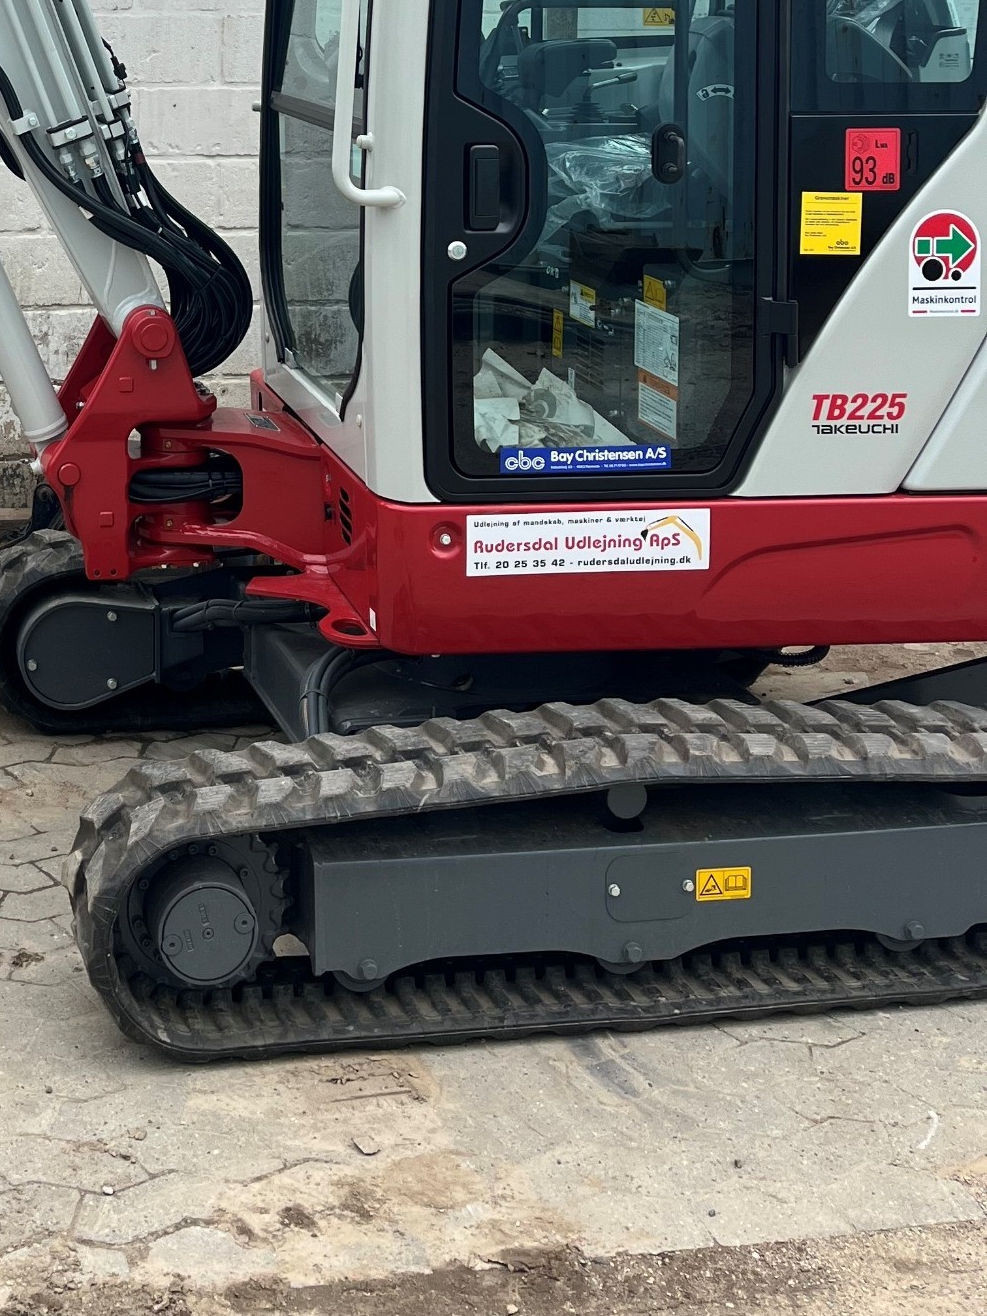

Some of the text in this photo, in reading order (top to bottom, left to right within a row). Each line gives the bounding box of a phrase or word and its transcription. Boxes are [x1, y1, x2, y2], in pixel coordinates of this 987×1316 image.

[852, 155, 895, 185] 93 dB
[912, 295, 977, 304] Maskinkontrol
[812, 392, 908, 421] TB225
[505, 450, 545, 471] cbc
[550, 450, 574, 465] Bay
[575, 448, 643, 462] Christensen
[645, 446, 667, 459] A/S
[523, 518, 564, 526] mandskab,
[474, 533, 681, 554] Rudersdal Udlejning ApS
[474, 562, 490, 570] Tlf.
[495, 561, 509, 569] 20
[514, 560, 528, 568] 25
[533, 559, 546, 568] 35
[551, 559, 565, 567] 42
[577, 555, 691, 566] rudersdaludlejning.dk
